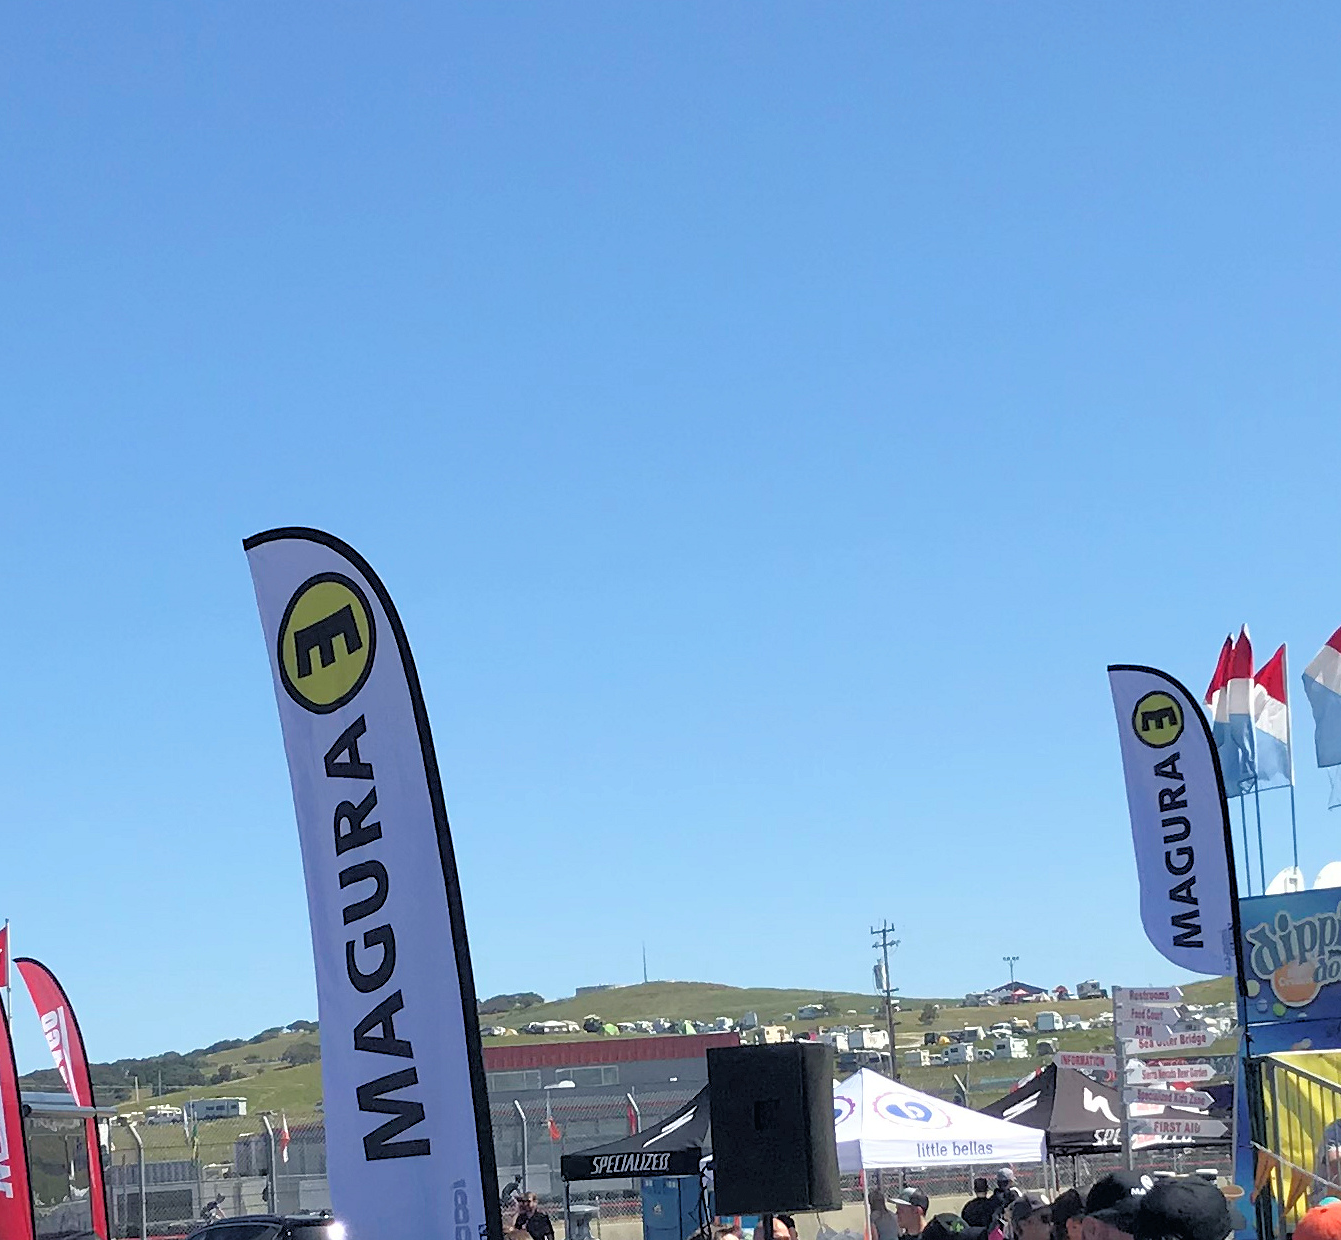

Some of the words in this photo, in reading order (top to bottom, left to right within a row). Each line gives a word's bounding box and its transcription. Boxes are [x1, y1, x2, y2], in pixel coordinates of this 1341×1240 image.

[1154, 752, 1204, 949] MAGURA
[324, 713, 431, 1161] MAGURA
[1135, 1026, 1152, 1037] ATM
[1180, 1033, 1206, 1046] Bridge
[1060, 1055, 1105, 1067] INFORMATION
[1154, 1121, 1182, 1133] FIRST
[1184, 1122, 1201, 1133] AID
[917, 1142, 948, 1158] little
[953, 1141, 993, 1155] bellas
[591, 1153, 670, 1175] SPECIALIZED
